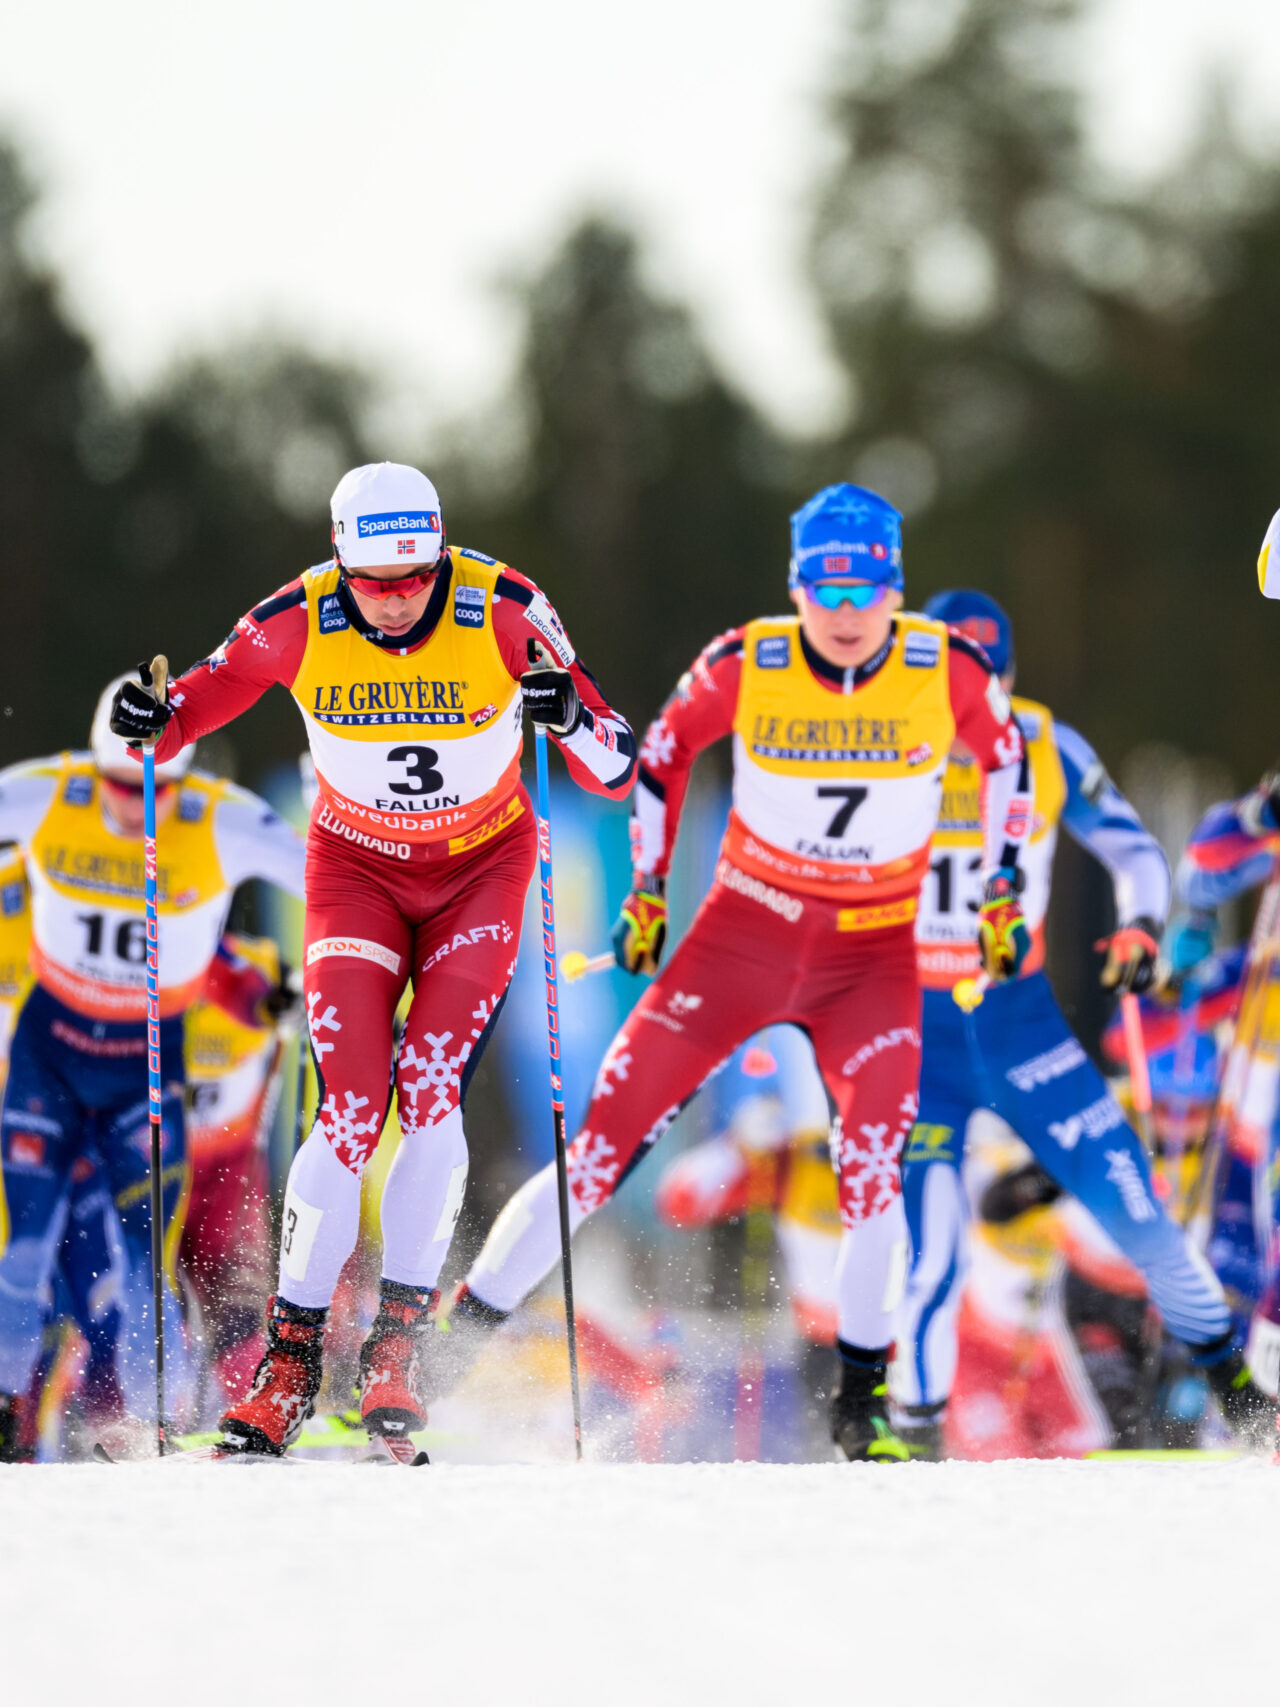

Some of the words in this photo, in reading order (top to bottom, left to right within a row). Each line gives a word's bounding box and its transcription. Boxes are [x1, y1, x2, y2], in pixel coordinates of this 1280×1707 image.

[359, 516, 430, 535] SpareBank
[323, 617, 346, 629] coop
[455, 608, 483, 623] coop
[525, 608, 572, 667] TORGHATTEN
[313, 686, 343, 712] LE
[319, 712, 459, 724] SWITZERLAND
[753, 714, 780, 742] LE
[787, 714, 901, 747] GRUYÈRE
[387, 745, 444, 796] 3
[754, 745, 898, 761] SWITZERLAND
[331, 795, 468, 832] Swedbank
[375, 795, 460, 812] FALUN
[817, 786, 869, 839] 7
[317, 806, 411, 860] ELDORADO
[462, 807, 519, 848] DHL
[797, 839, 872, 860] FALUN
[76, 912, 159, 966] 16
[421, 924, 501, 973] CRAFT
[364, 945, 400, 970] SPORT
[540, 875, 561, 1060] TORNADO
[146, 893, 161, 1075] TORNADO
